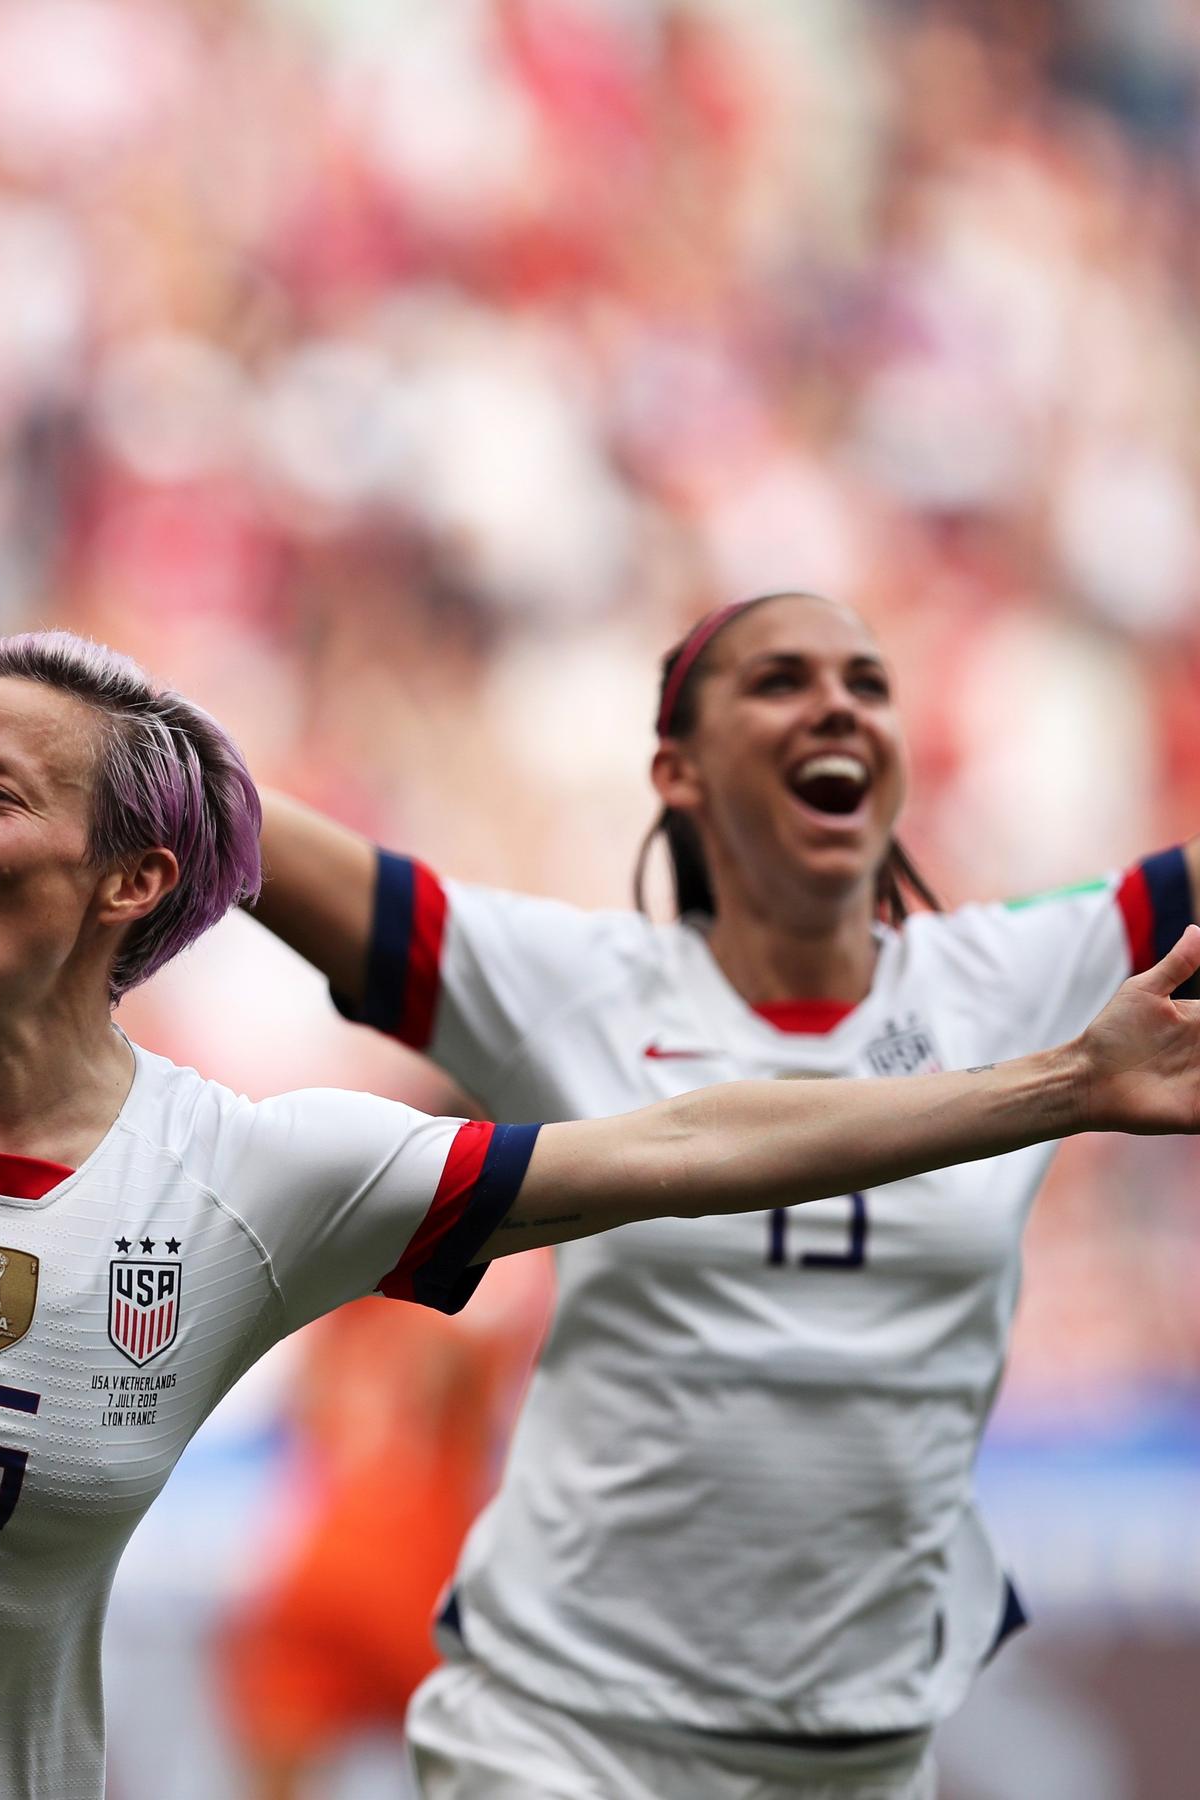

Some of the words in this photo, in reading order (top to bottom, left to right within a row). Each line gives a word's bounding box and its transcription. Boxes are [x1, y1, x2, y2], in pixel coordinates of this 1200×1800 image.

[116, 1268, 175, 1308] USA
[91, 1375, 109, 1390] USA
[113, 1376, 119, 1390] V
[119, 1373, 177, 1391] NETHERLANDS
[108, 1393, 114, 1408] 7
[115, 1393, 135, 1408] JULY
[137, 1393, 158, 1408] 2019
[102, 1412, 124, 1427] LYON
[126, 1410, 157, 1427] FRANCE
